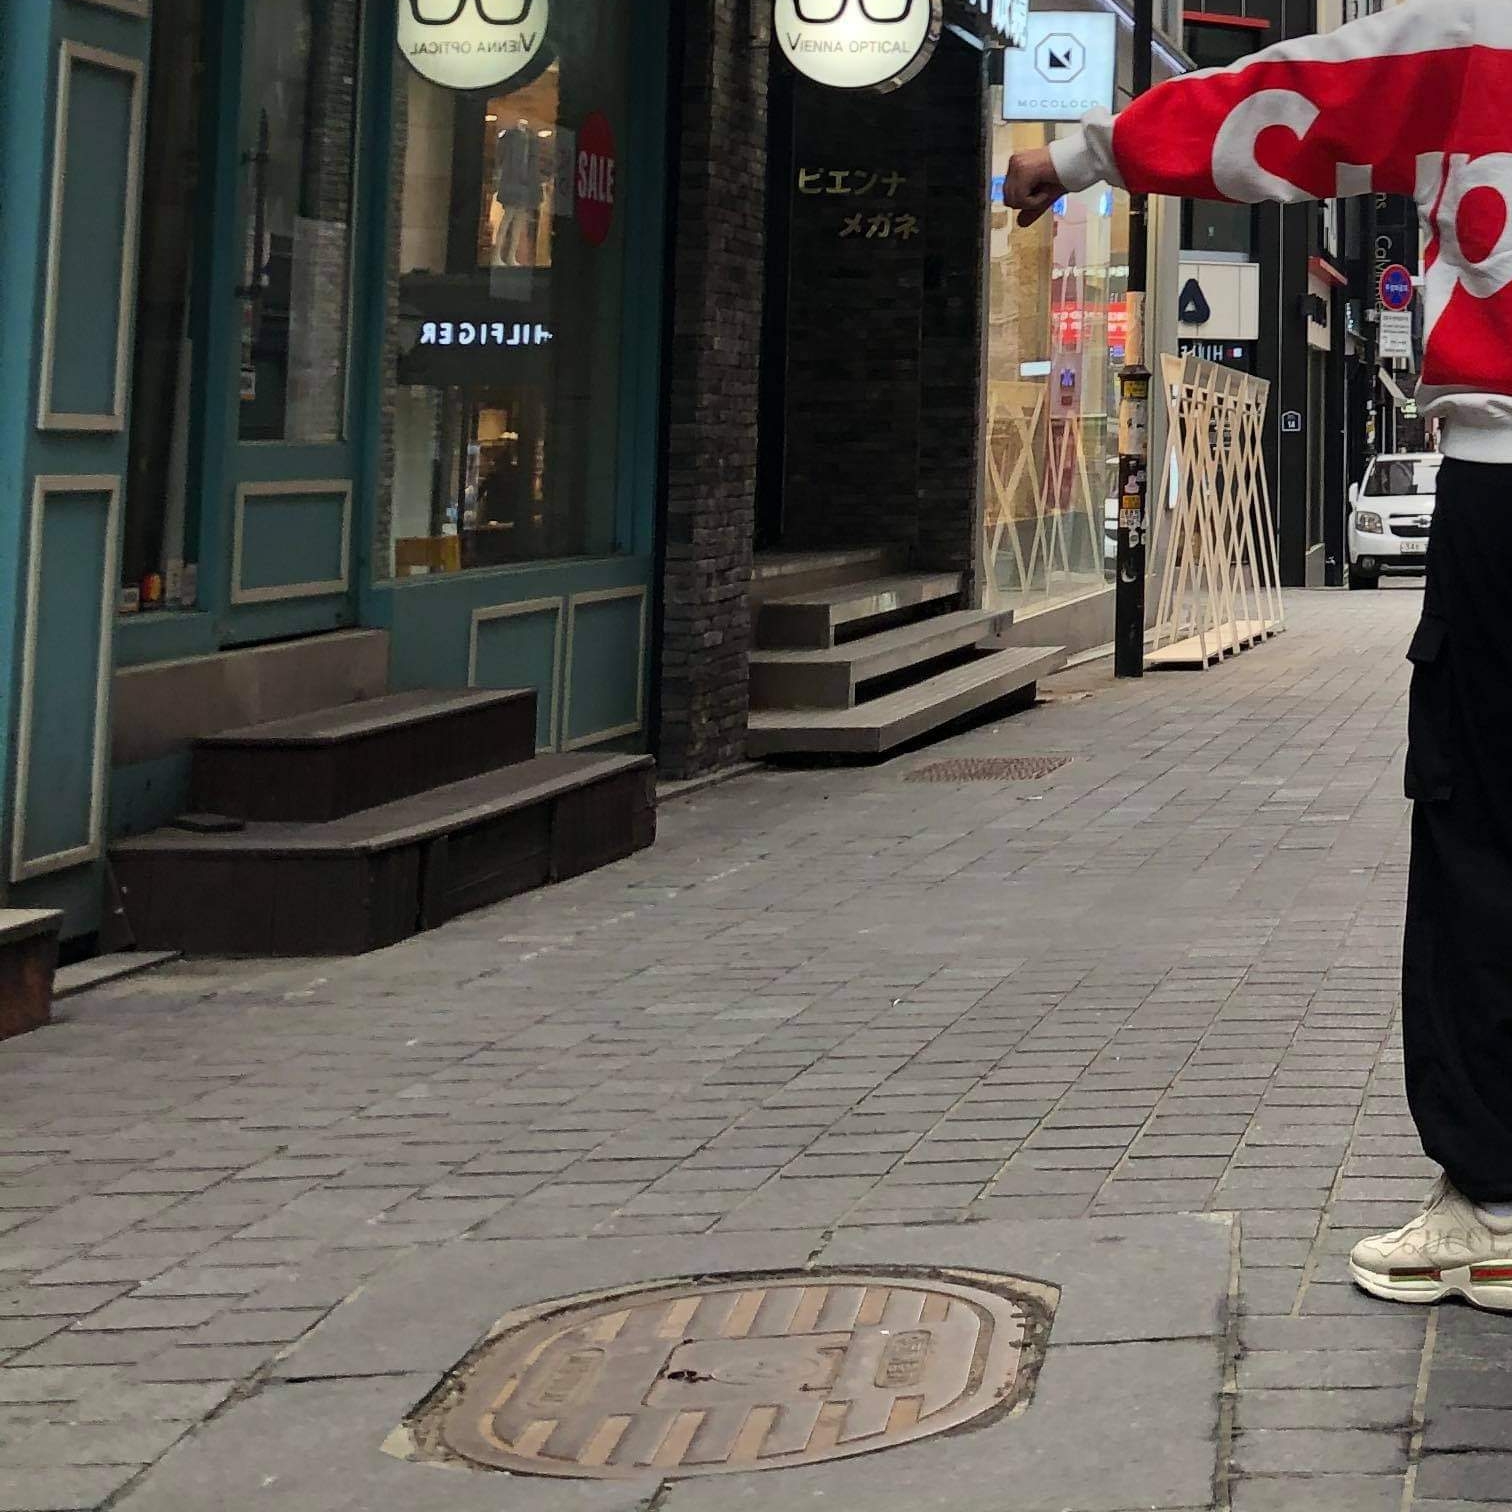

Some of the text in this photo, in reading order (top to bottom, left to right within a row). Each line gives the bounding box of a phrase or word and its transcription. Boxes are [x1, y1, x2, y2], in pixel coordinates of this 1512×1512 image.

[787, 32, 911, 54] VIENNA OPTICAL
[578, 150, 615, 204] SALE
[799, 167, 907, 197] ビエンナ
[838, 211, 920, 240] メガネ
